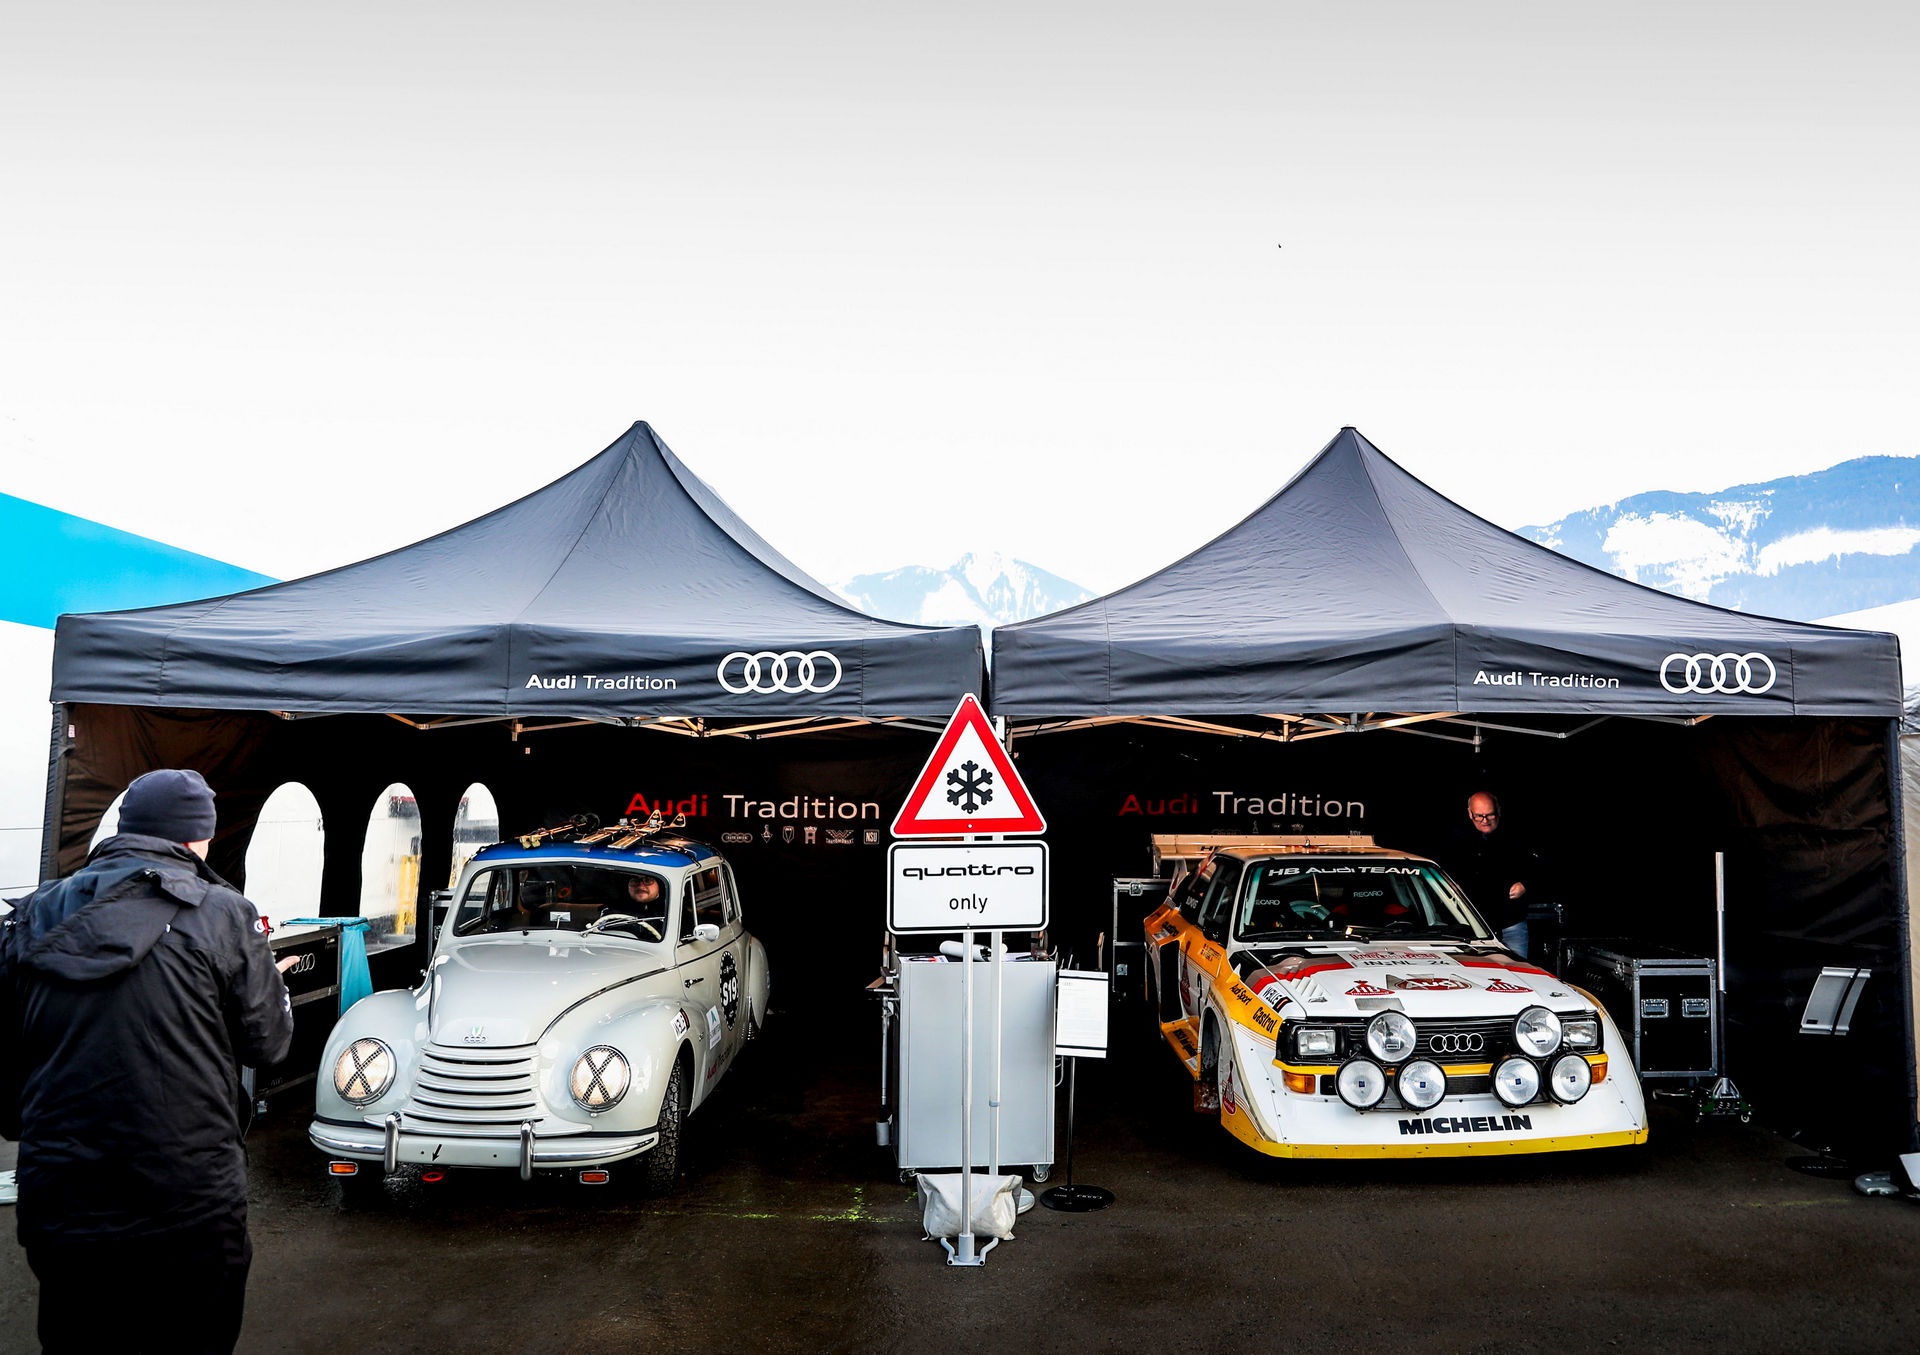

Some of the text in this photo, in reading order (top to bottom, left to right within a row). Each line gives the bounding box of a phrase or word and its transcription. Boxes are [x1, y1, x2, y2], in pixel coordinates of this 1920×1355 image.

[525, 674, 677, 690] Audi Tradition
[1473, 670, 1620, 689] Audi Tradition
[625, 793, 880, 819] Audi Tradition
[1118, 791, 1365, 819] Audi Tradition
[903, 864, 1034, 880] quattro
[1268, 866, 1421, 876] HB Audi TEAM
[949, 893, 988, 914] only
[1353, 890, 1384, 898] RECARO
[723, 977, 737, 1006] S19
[1236, 989, 1253, 1005] Sport
[1252, 1006, 1278, 1033] Castrol
[1398, 1115, 1533, 1135] MICHELIN
